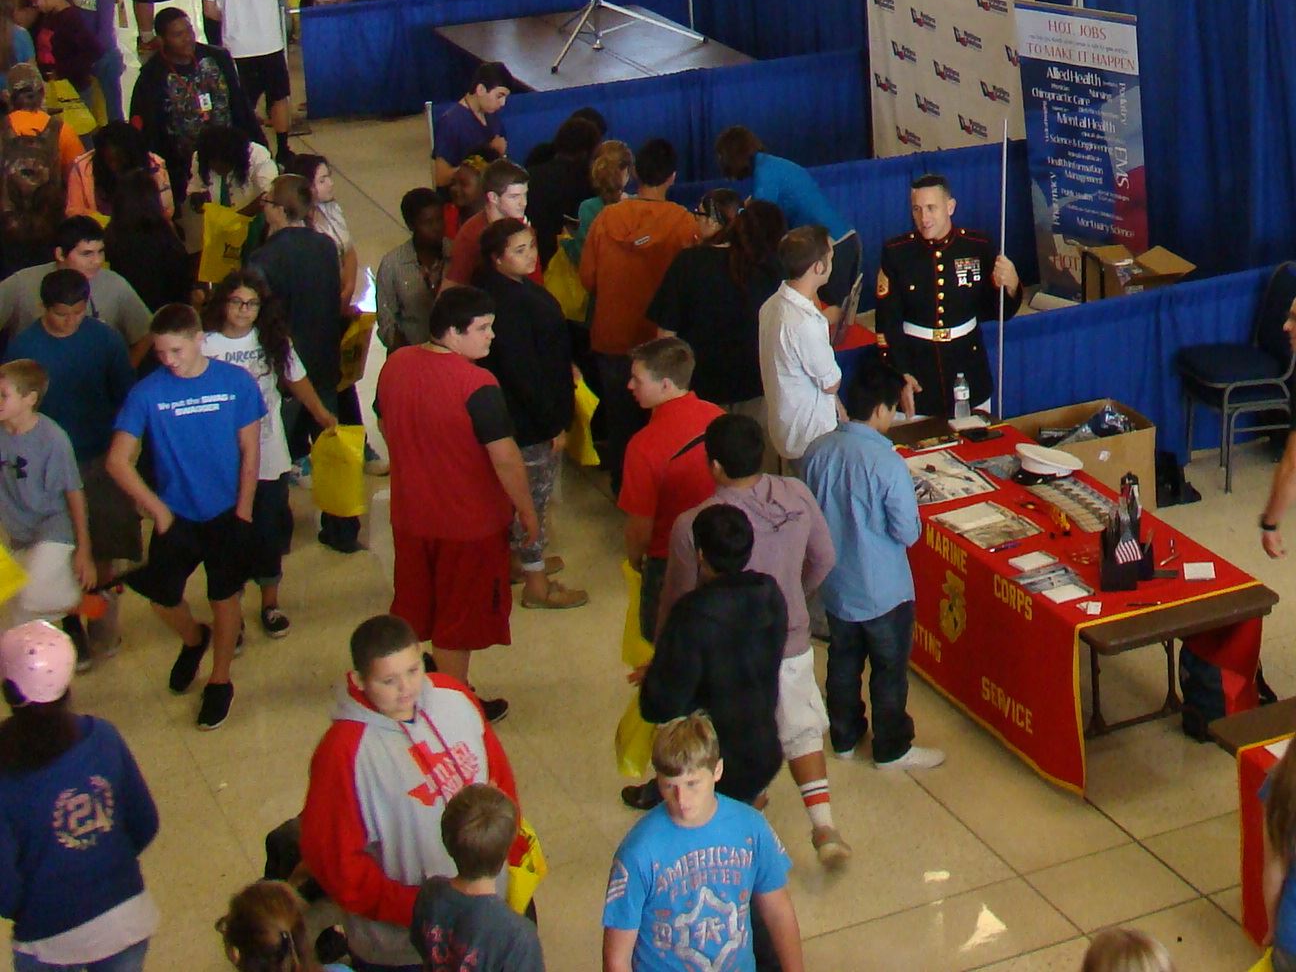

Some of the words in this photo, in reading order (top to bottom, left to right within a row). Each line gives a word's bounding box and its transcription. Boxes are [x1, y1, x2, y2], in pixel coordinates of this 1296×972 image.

[1048, 20, 1072, 34] HOT
[1080, 24, 1107, 40] JOBS
[1027, 42, 1043, 54] TO
[1044, 45, 1073, 62] MAKE
[1078, 50, 1088, 63] IT
[1092, 53, 1135, 71] HAPPEN
[1046, 66, 1070, 80] Allied
[1070, 68, 1101, 87] Health
[1032, 88, 1072, 103] Chiropractic
[1073, 96, 1091, 106] Care
[1057, 112, 1087, 128] Mental
[1087, 117, 1116, 133] Health
[1115, 147, 1129, 189] EMS
[1077, 217, 1109, 234] Mortuary
[1110, 222, 1135, 237] Science
[926, 523, 967, 576] MARINE
[993, 574, 1033, 621] CORPS
[981, 676, 1033, 734] SERVICE
[656, 846, 753, 895] AMERICAN
[670, 869, 742, 903] FIGHTER
